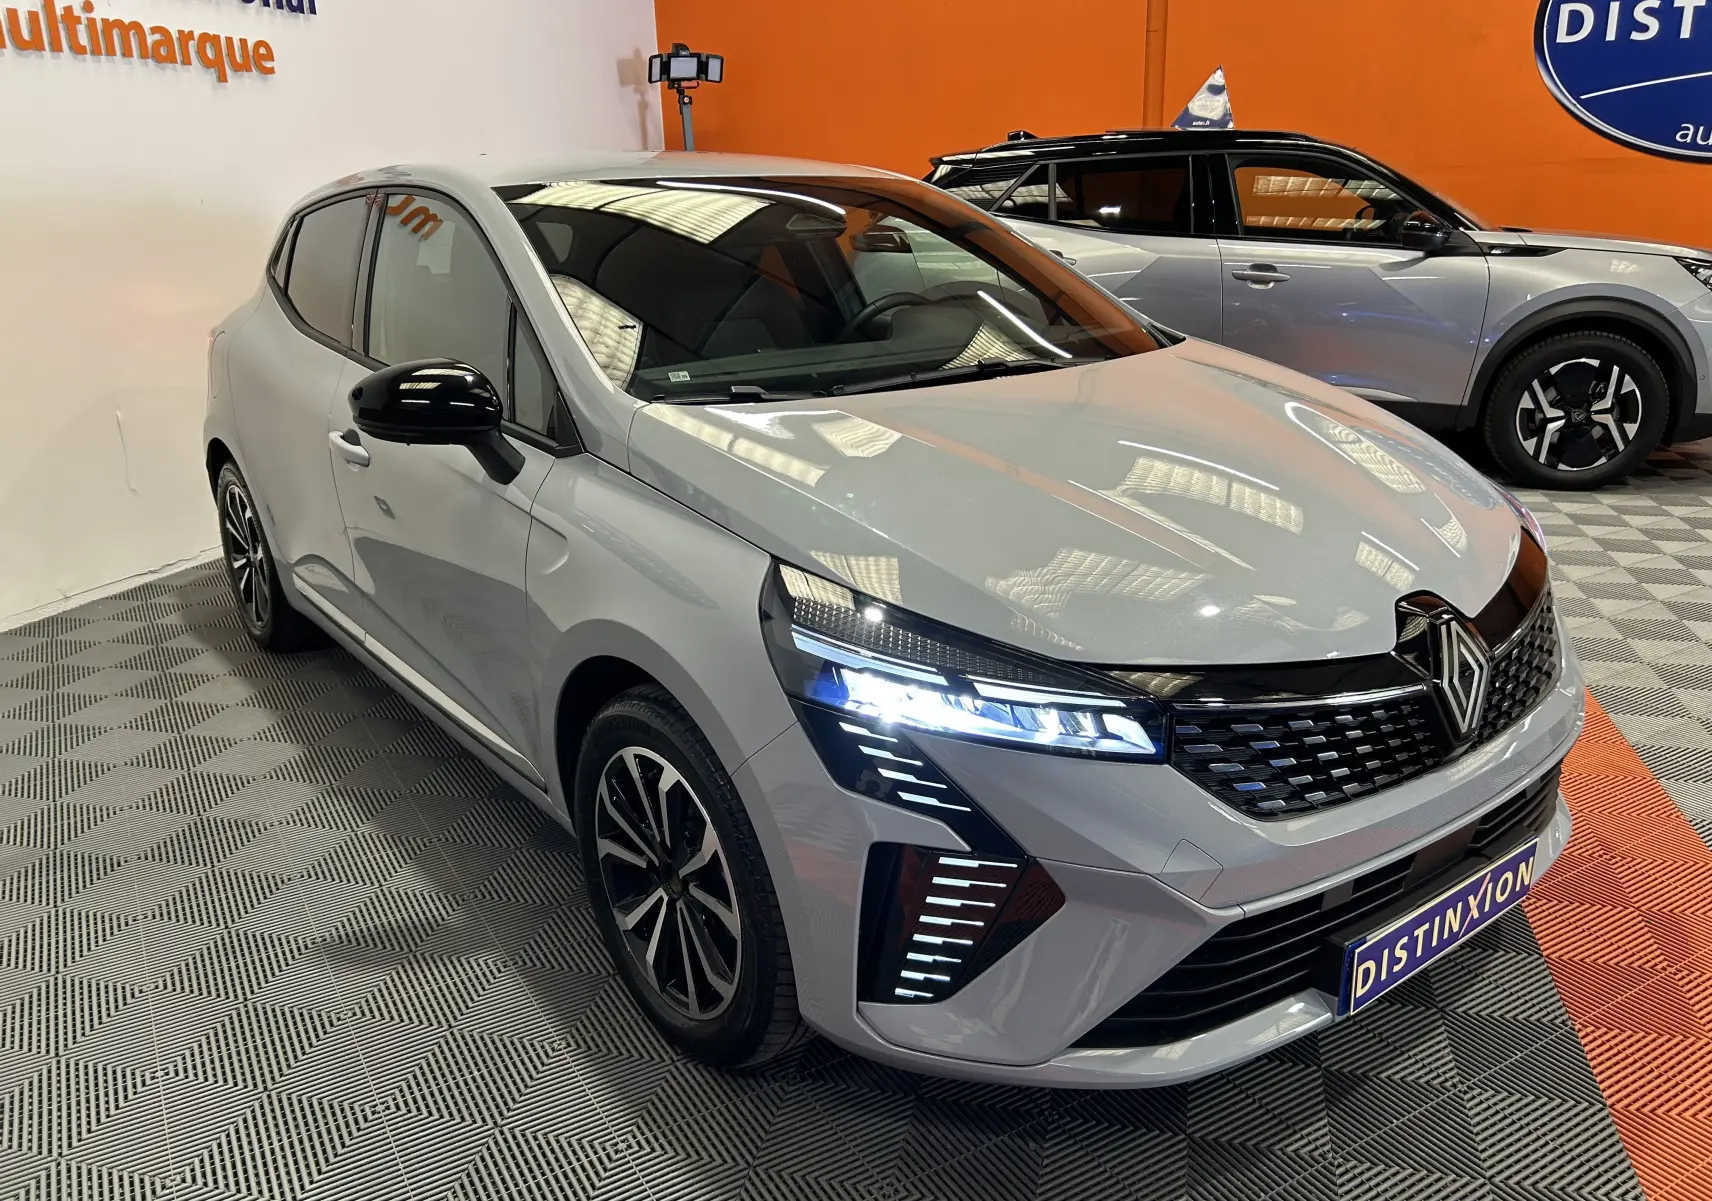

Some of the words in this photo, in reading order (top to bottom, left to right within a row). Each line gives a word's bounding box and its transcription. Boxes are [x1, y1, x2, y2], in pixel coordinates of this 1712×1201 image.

[0, 0, 276, 83] ultimarque
[1556, 0, 1706, 43] DIST
[1355, 856, 1534, 998] DISTINXION
